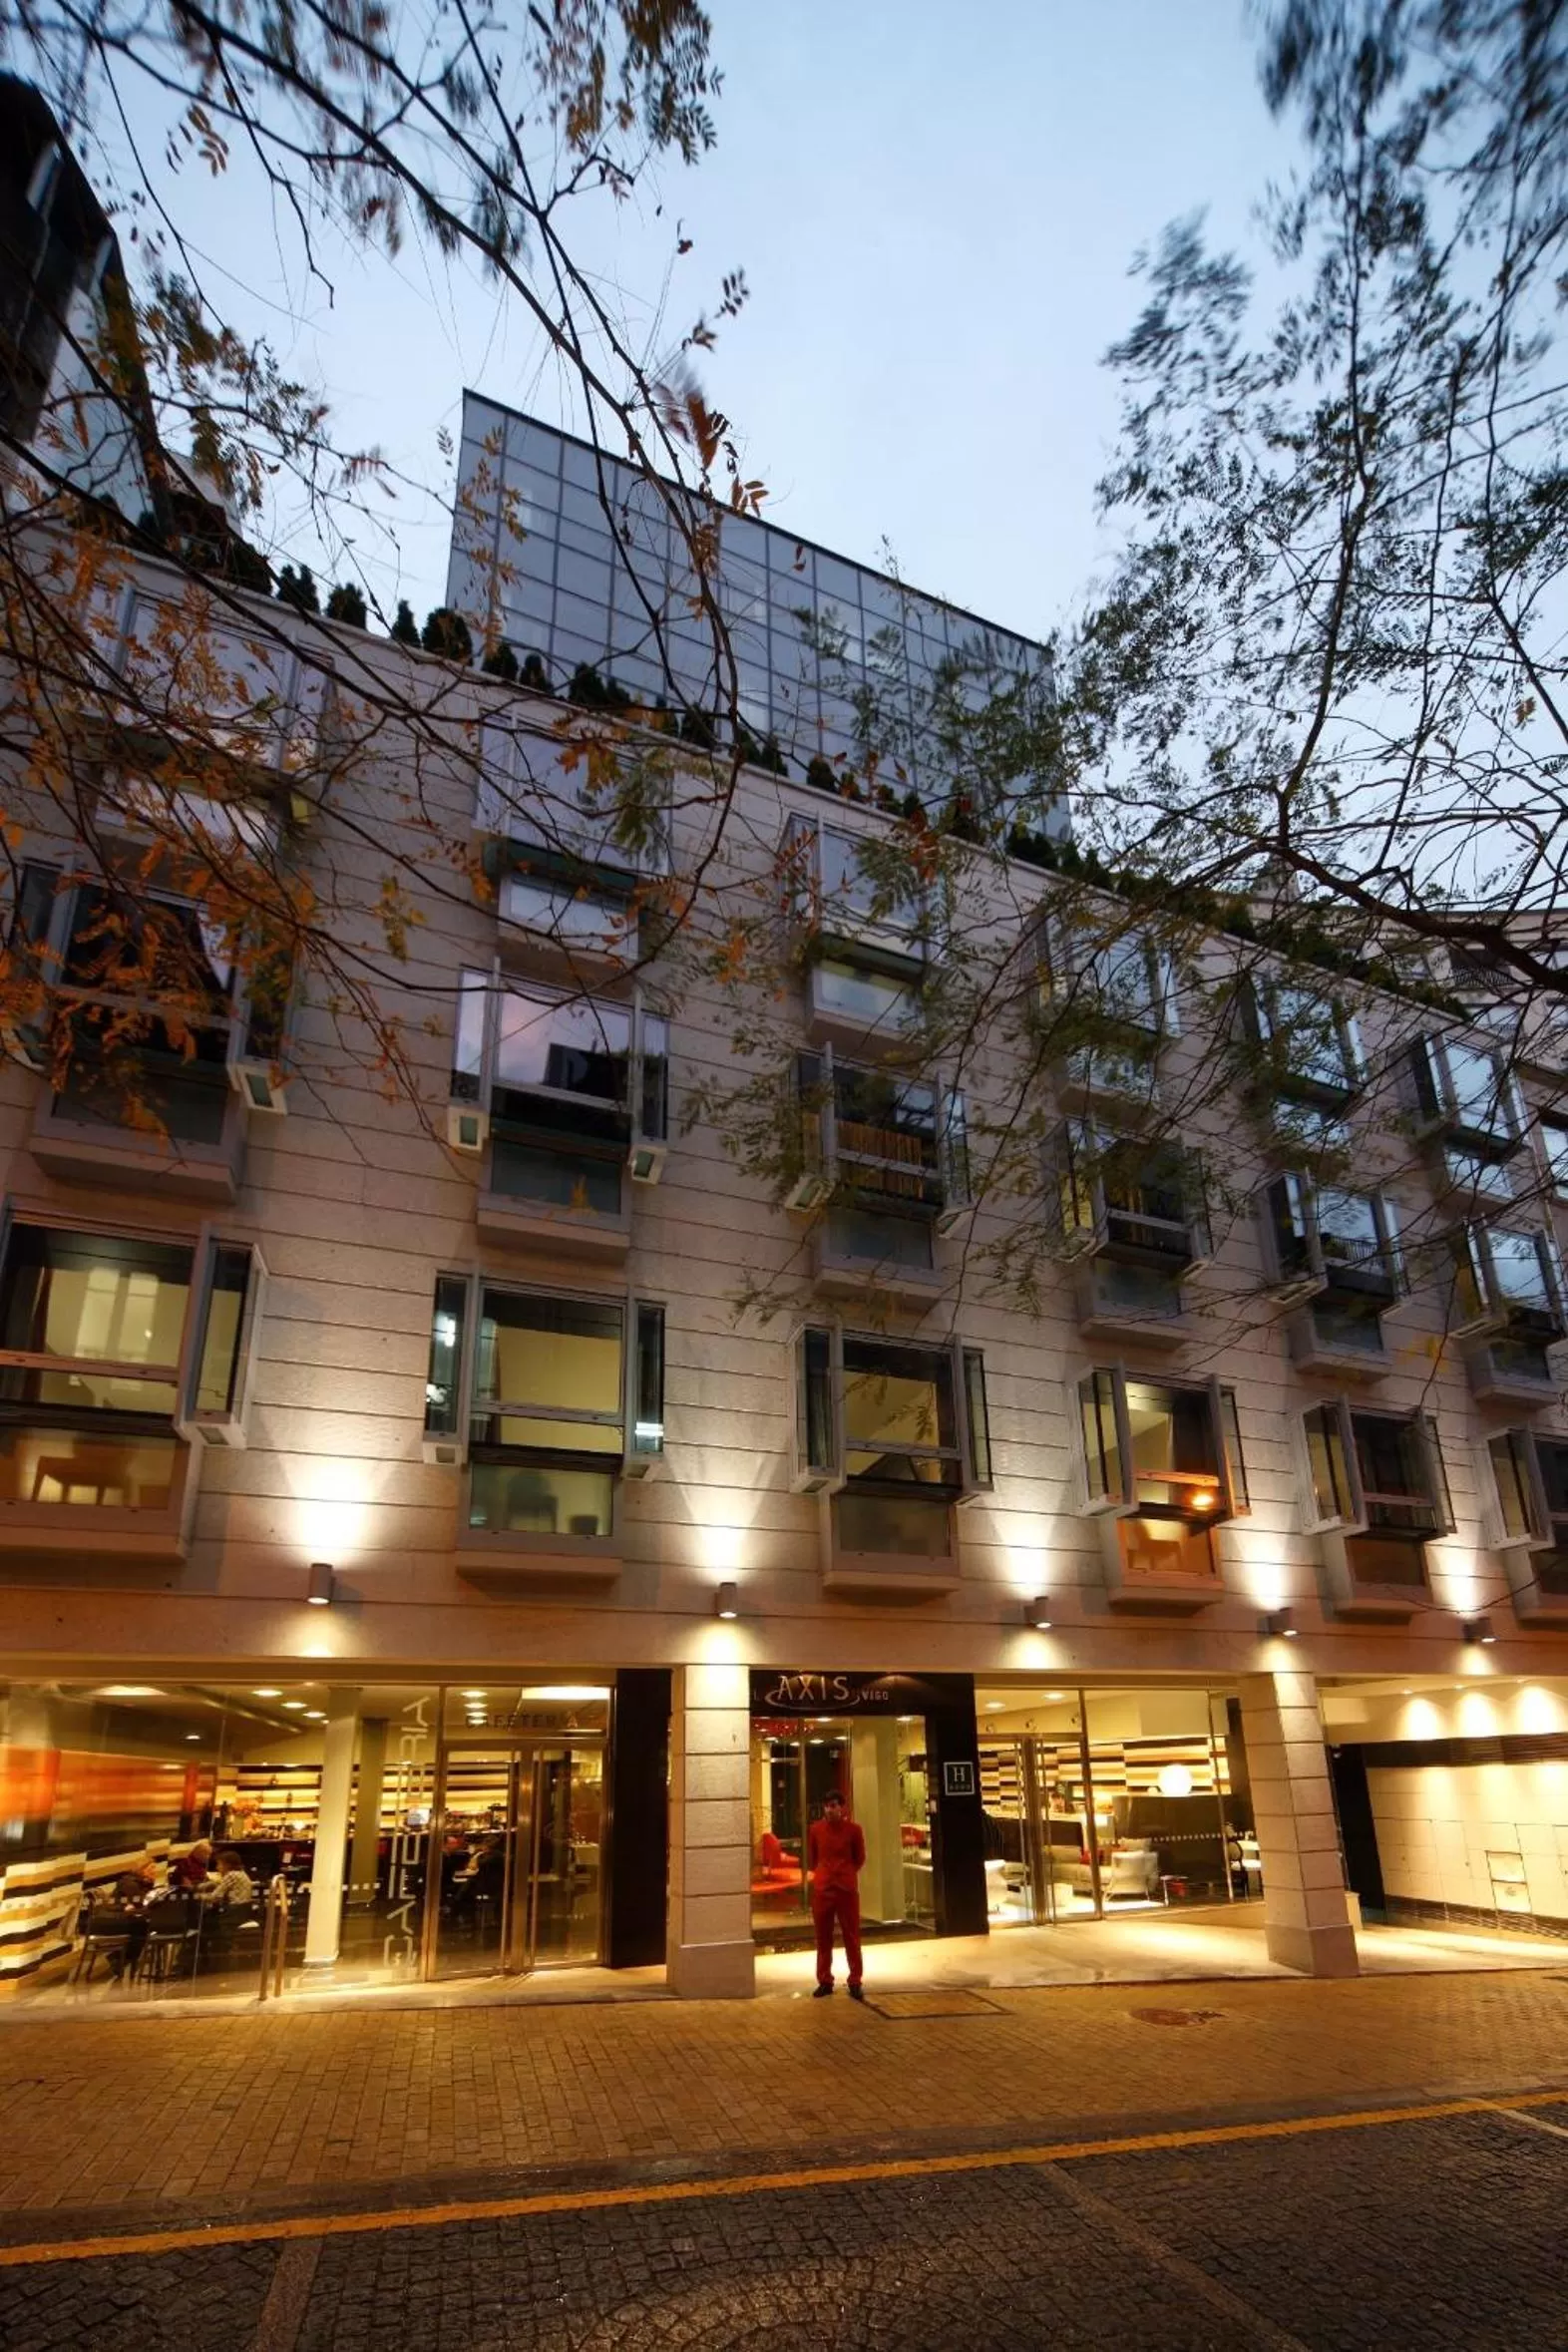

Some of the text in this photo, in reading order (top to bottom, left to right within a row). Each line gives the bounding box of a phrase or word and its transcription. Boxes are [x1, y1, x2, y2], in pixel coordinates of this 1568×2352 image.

[777, 1675, 850, 1701] AXIS
[861, 1690, 889, 1701] VIGO
[465, 1713, 579, 1729] CAFETERA
[953, 1766, 966, 1782] H
